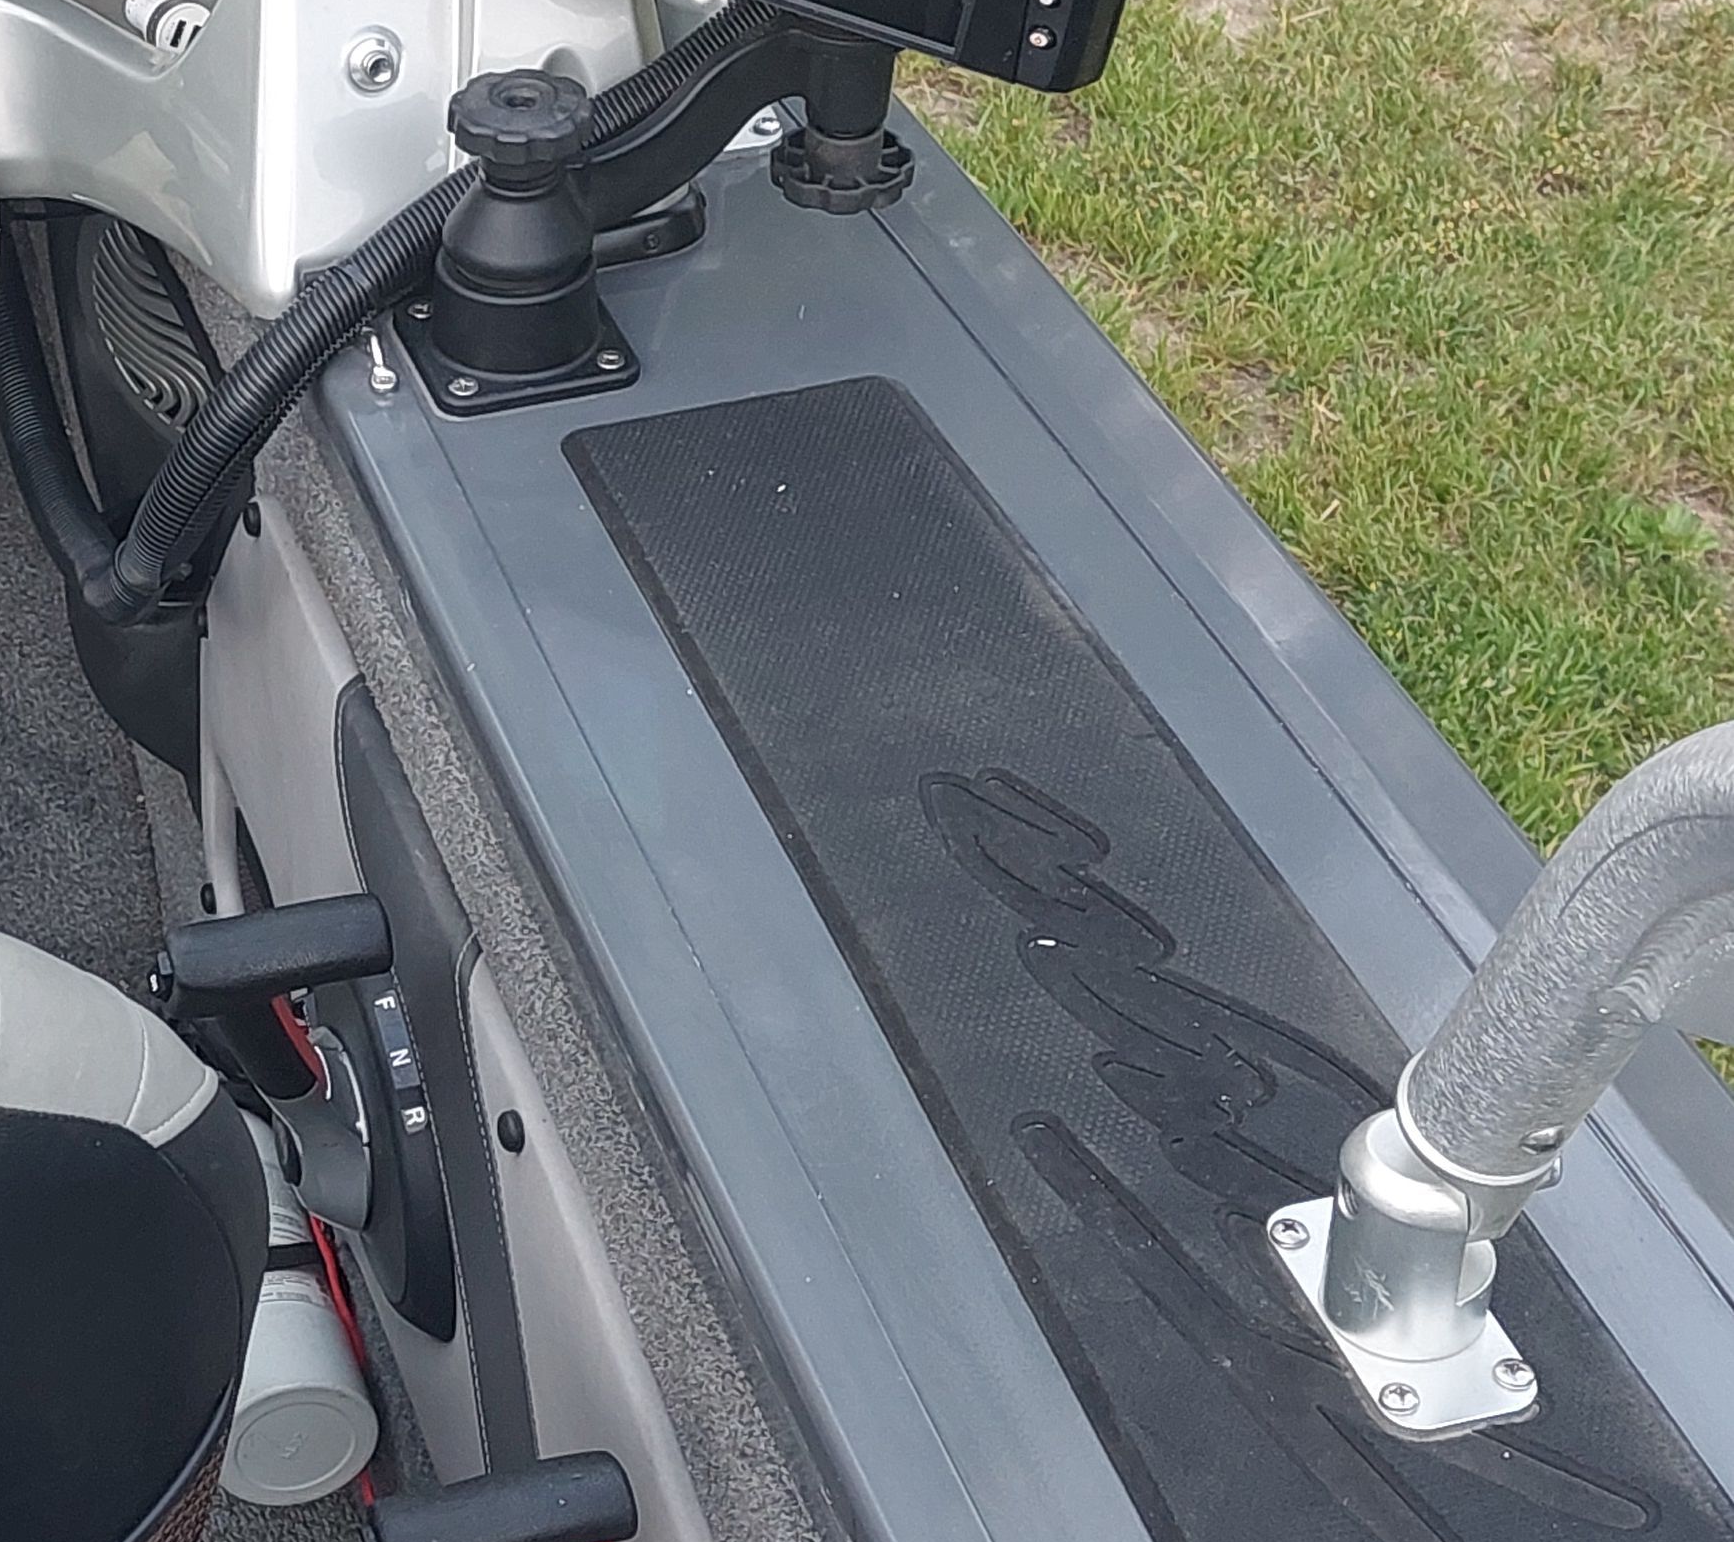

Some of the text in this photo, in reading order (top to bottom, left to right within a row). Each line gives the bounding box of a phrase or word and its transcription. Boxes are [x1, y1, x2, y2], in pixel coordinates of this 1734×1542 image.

[374, 995, 396, 1009] F
[389, 1048, 412, 1067] N
[403, 1106, 426, 1126] R
